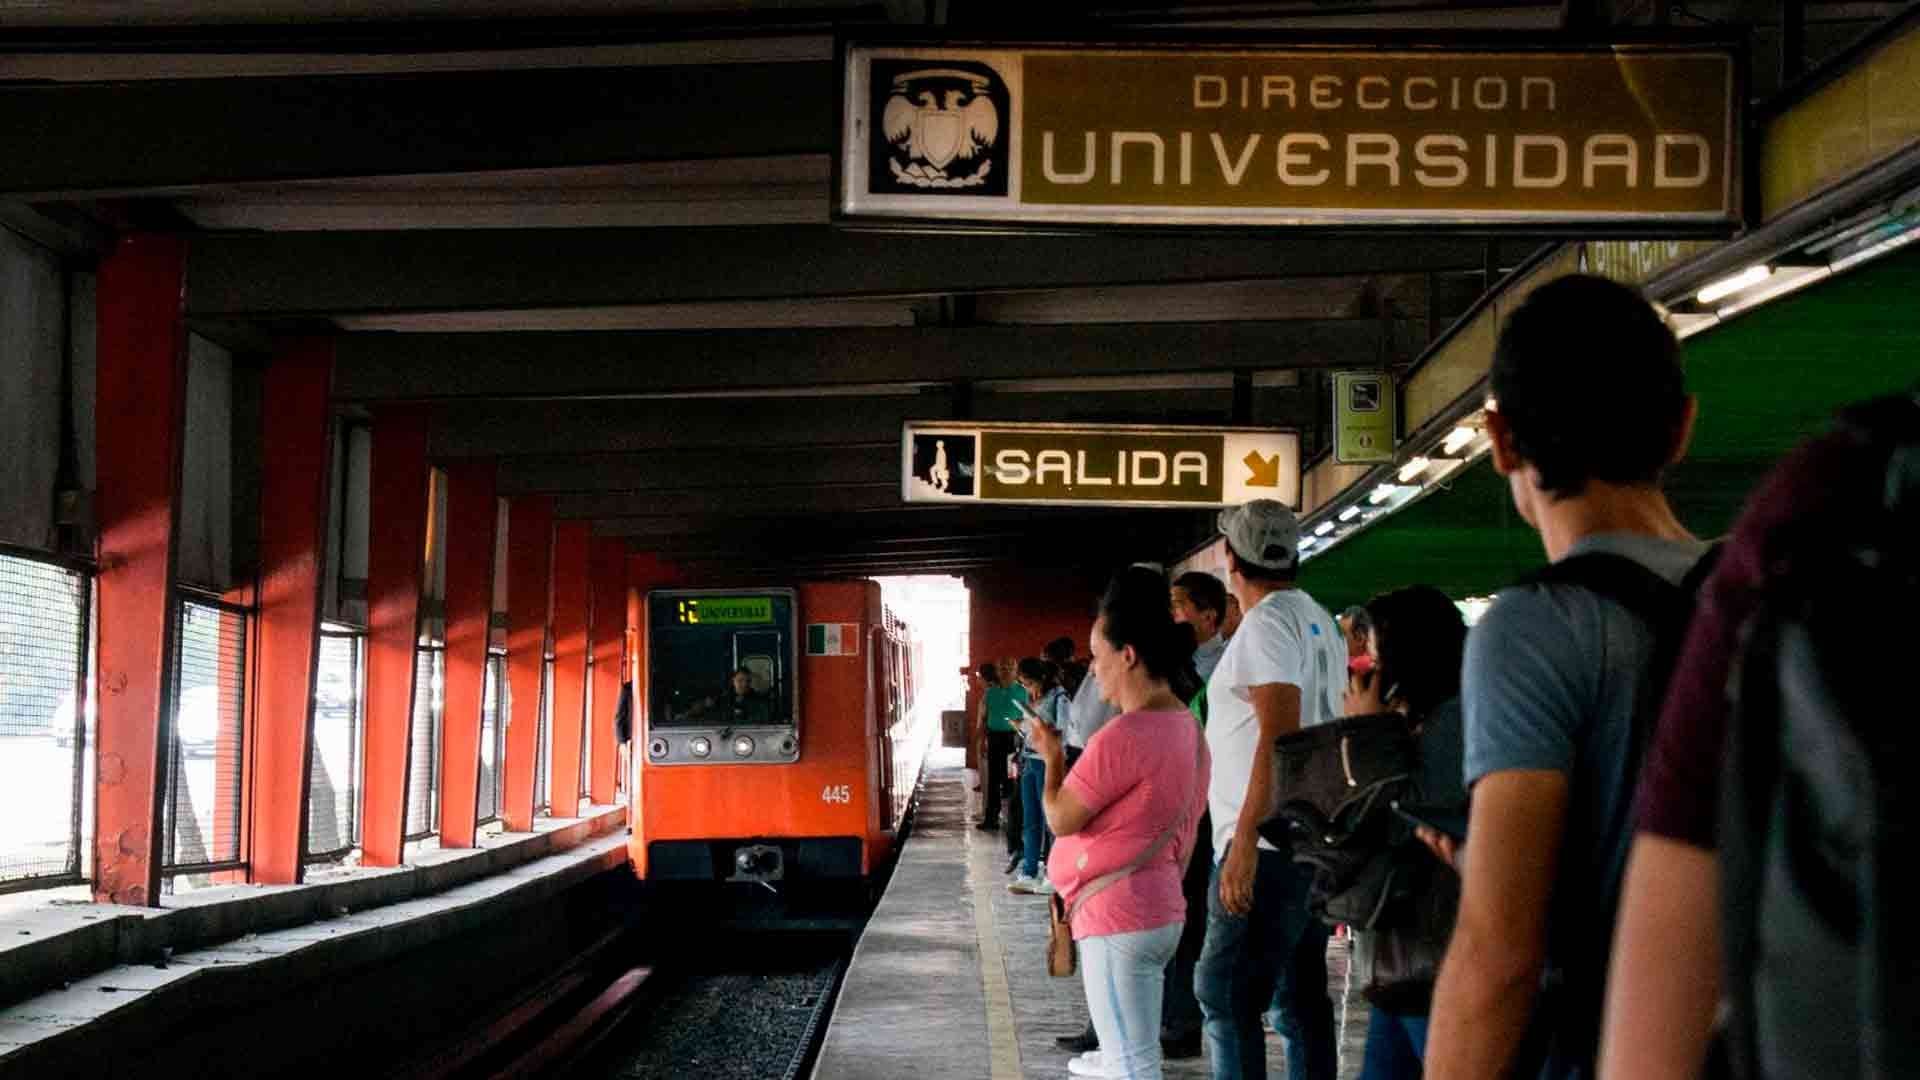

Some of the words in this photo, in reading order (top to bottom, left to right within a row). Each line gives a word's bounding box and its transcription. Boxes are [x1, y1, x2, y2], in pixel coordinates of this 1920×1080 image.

[1193, 74, 1556, 110] DIRECCION
[1042, 131, 1710, 188] UNIVERSIDAD
[995, 449, 1208, 486] SALIDA
[822, 784, 850, 804] 445
